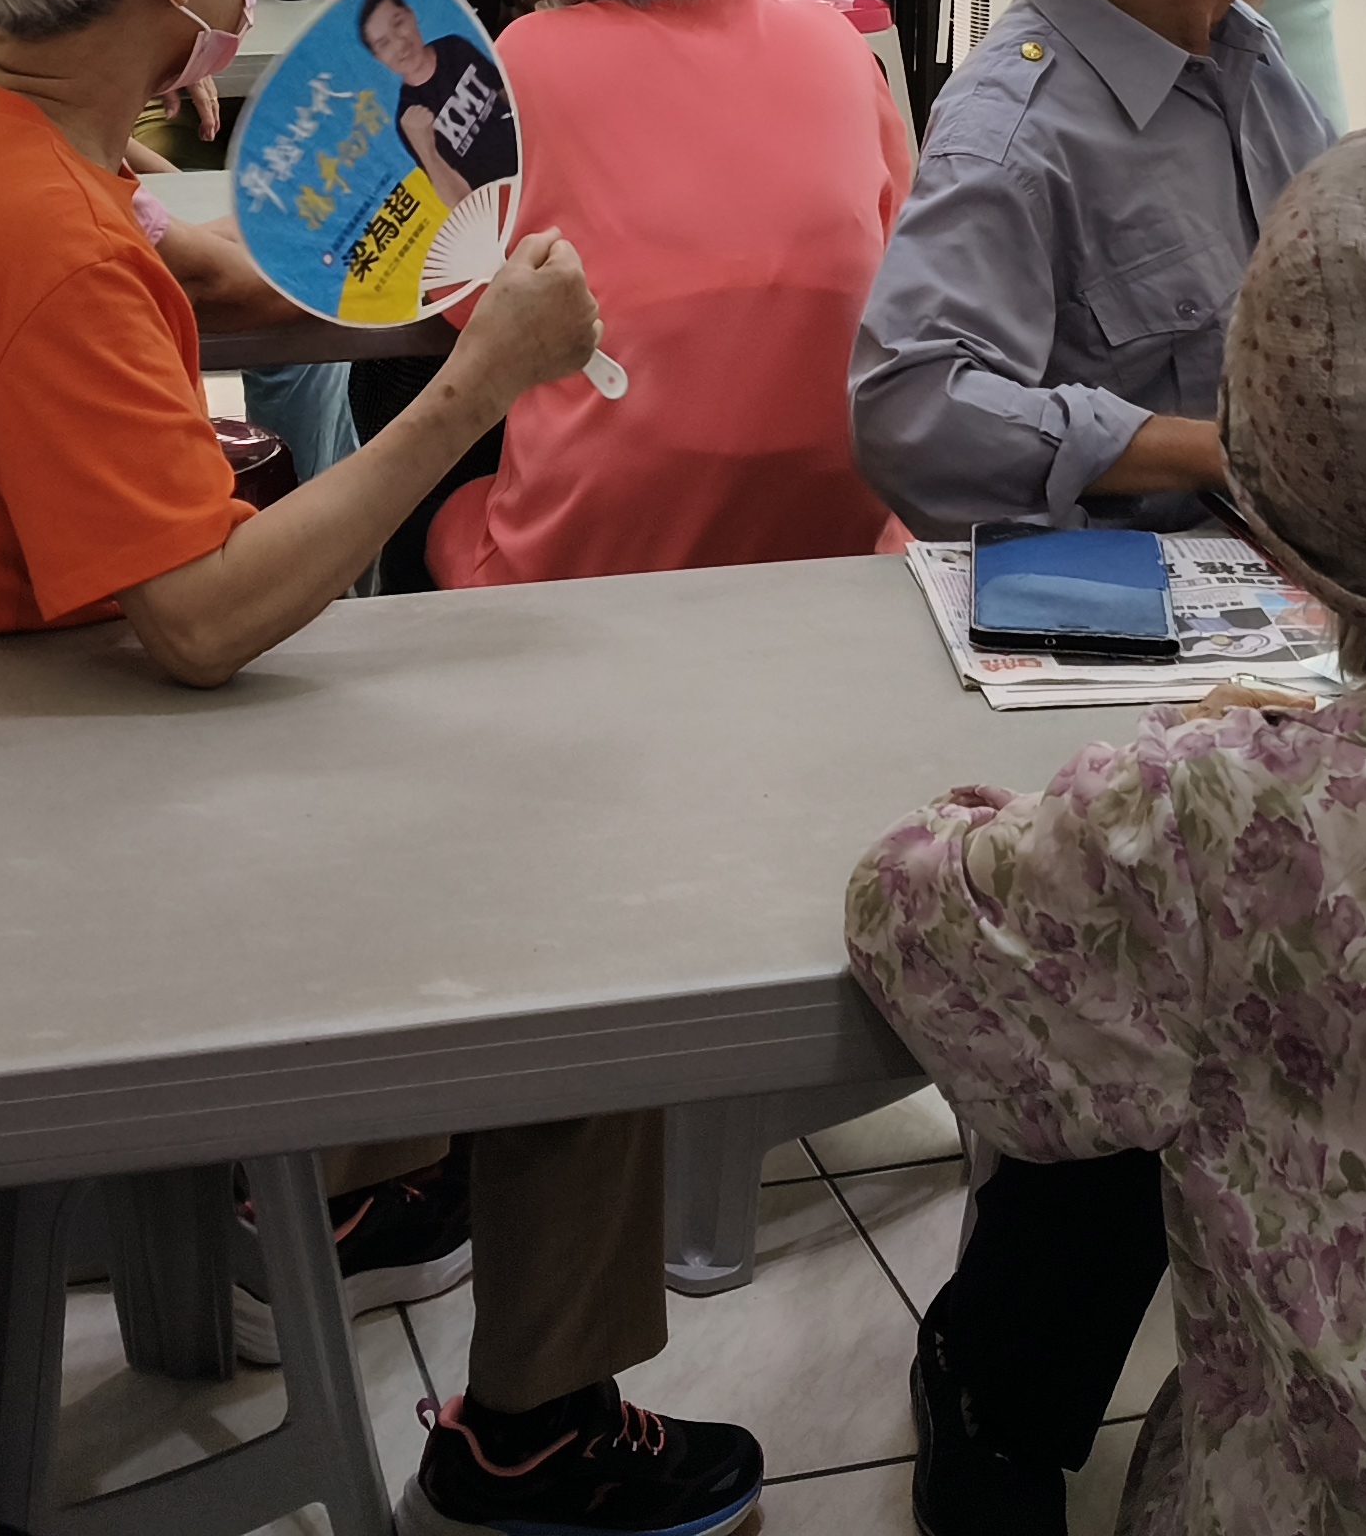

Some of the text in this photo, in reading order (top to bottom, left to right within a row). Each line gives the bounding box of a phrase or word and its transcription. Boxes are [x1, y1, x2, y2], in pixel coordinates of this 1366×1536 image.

[432, 62, 492, 152] KMT
[341, 181, 421, 284] 梁為超
